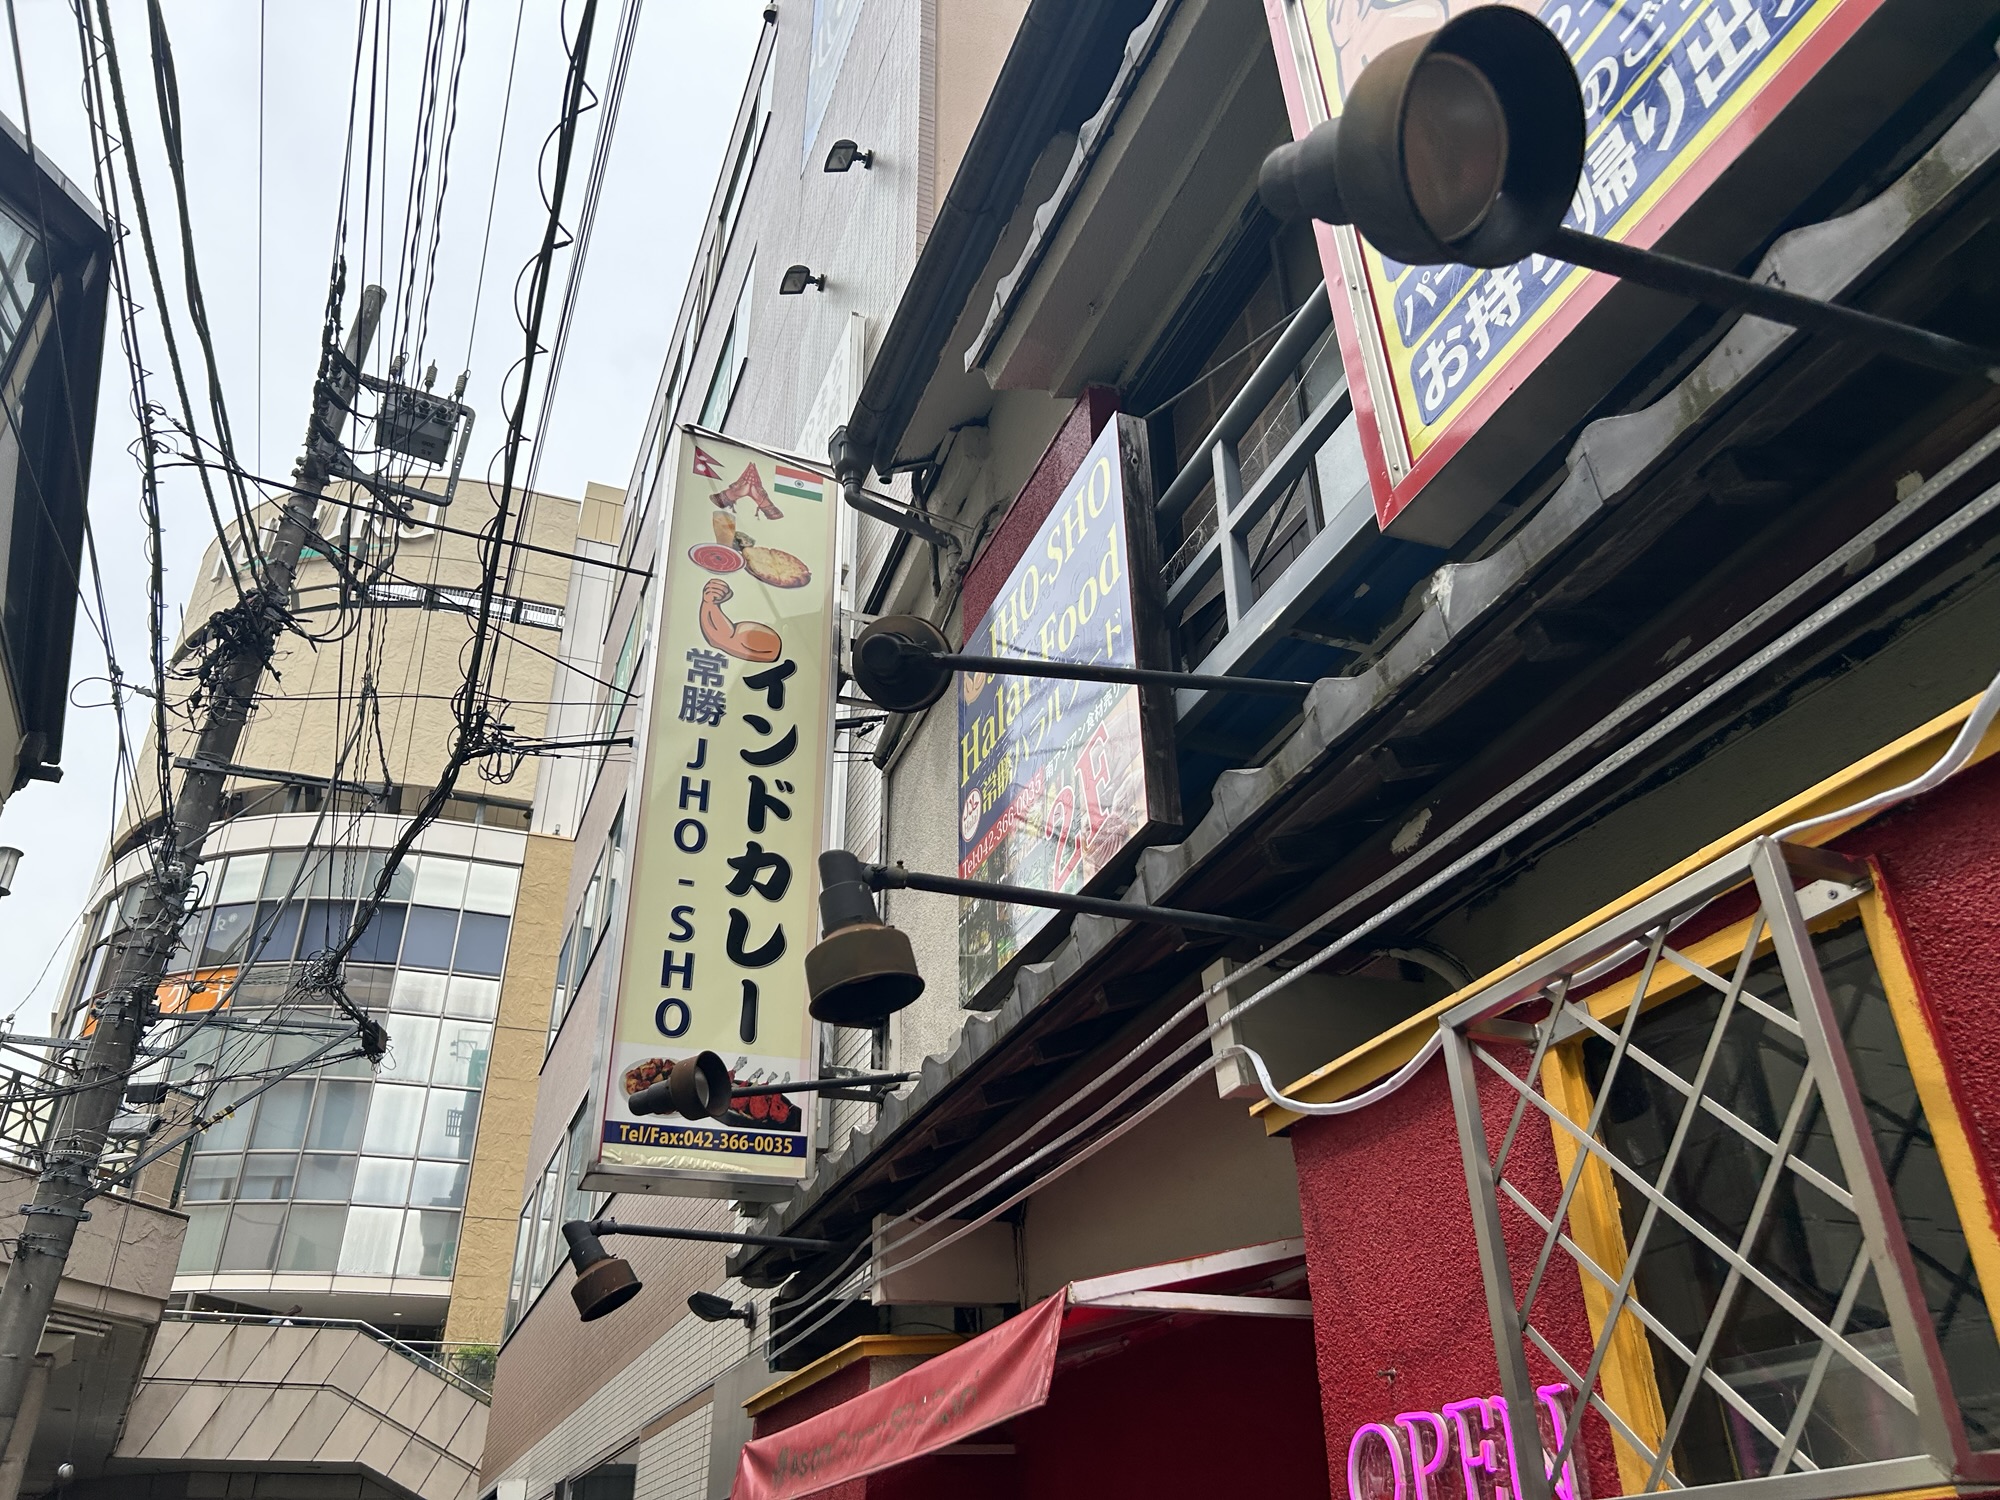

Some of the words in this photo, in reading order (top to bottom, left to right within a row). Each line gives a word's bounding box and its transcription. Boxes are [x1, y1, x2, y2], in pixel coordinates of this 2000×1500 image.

[210, 498, 440, 582] KUURU
[987, 457, 1111, 684] JHO-SHO
[1038, 521, 1122, 682] Food
[678, 648, 729, 728] 常勝
[1045, 720, 1112, 892] 2F
[620, 1125, 792, 1154] Tel/Fax:042-366-0035
[1348, 1383, 1574, 1500] OPEN
